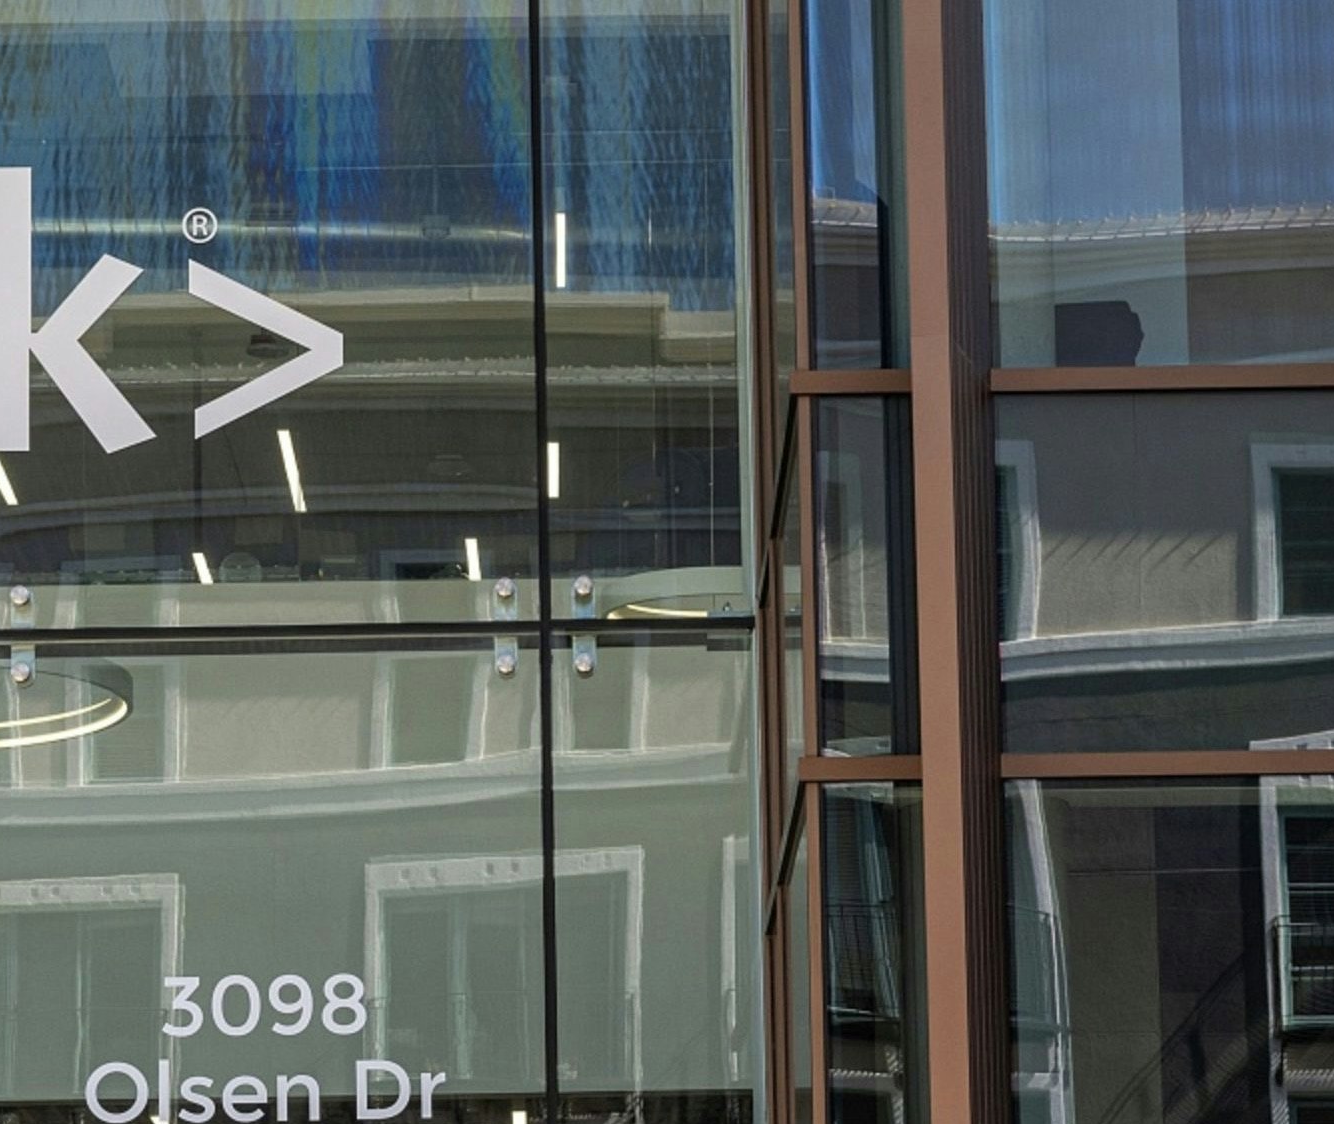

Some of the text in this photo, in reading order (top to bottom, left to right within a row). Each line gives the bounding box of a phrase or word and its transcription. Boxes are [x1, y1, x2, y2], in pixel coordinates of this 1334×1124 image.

[161, 973, 368, 1038] 3098
[84, 1058, 447, 1124] Olsen Dr
